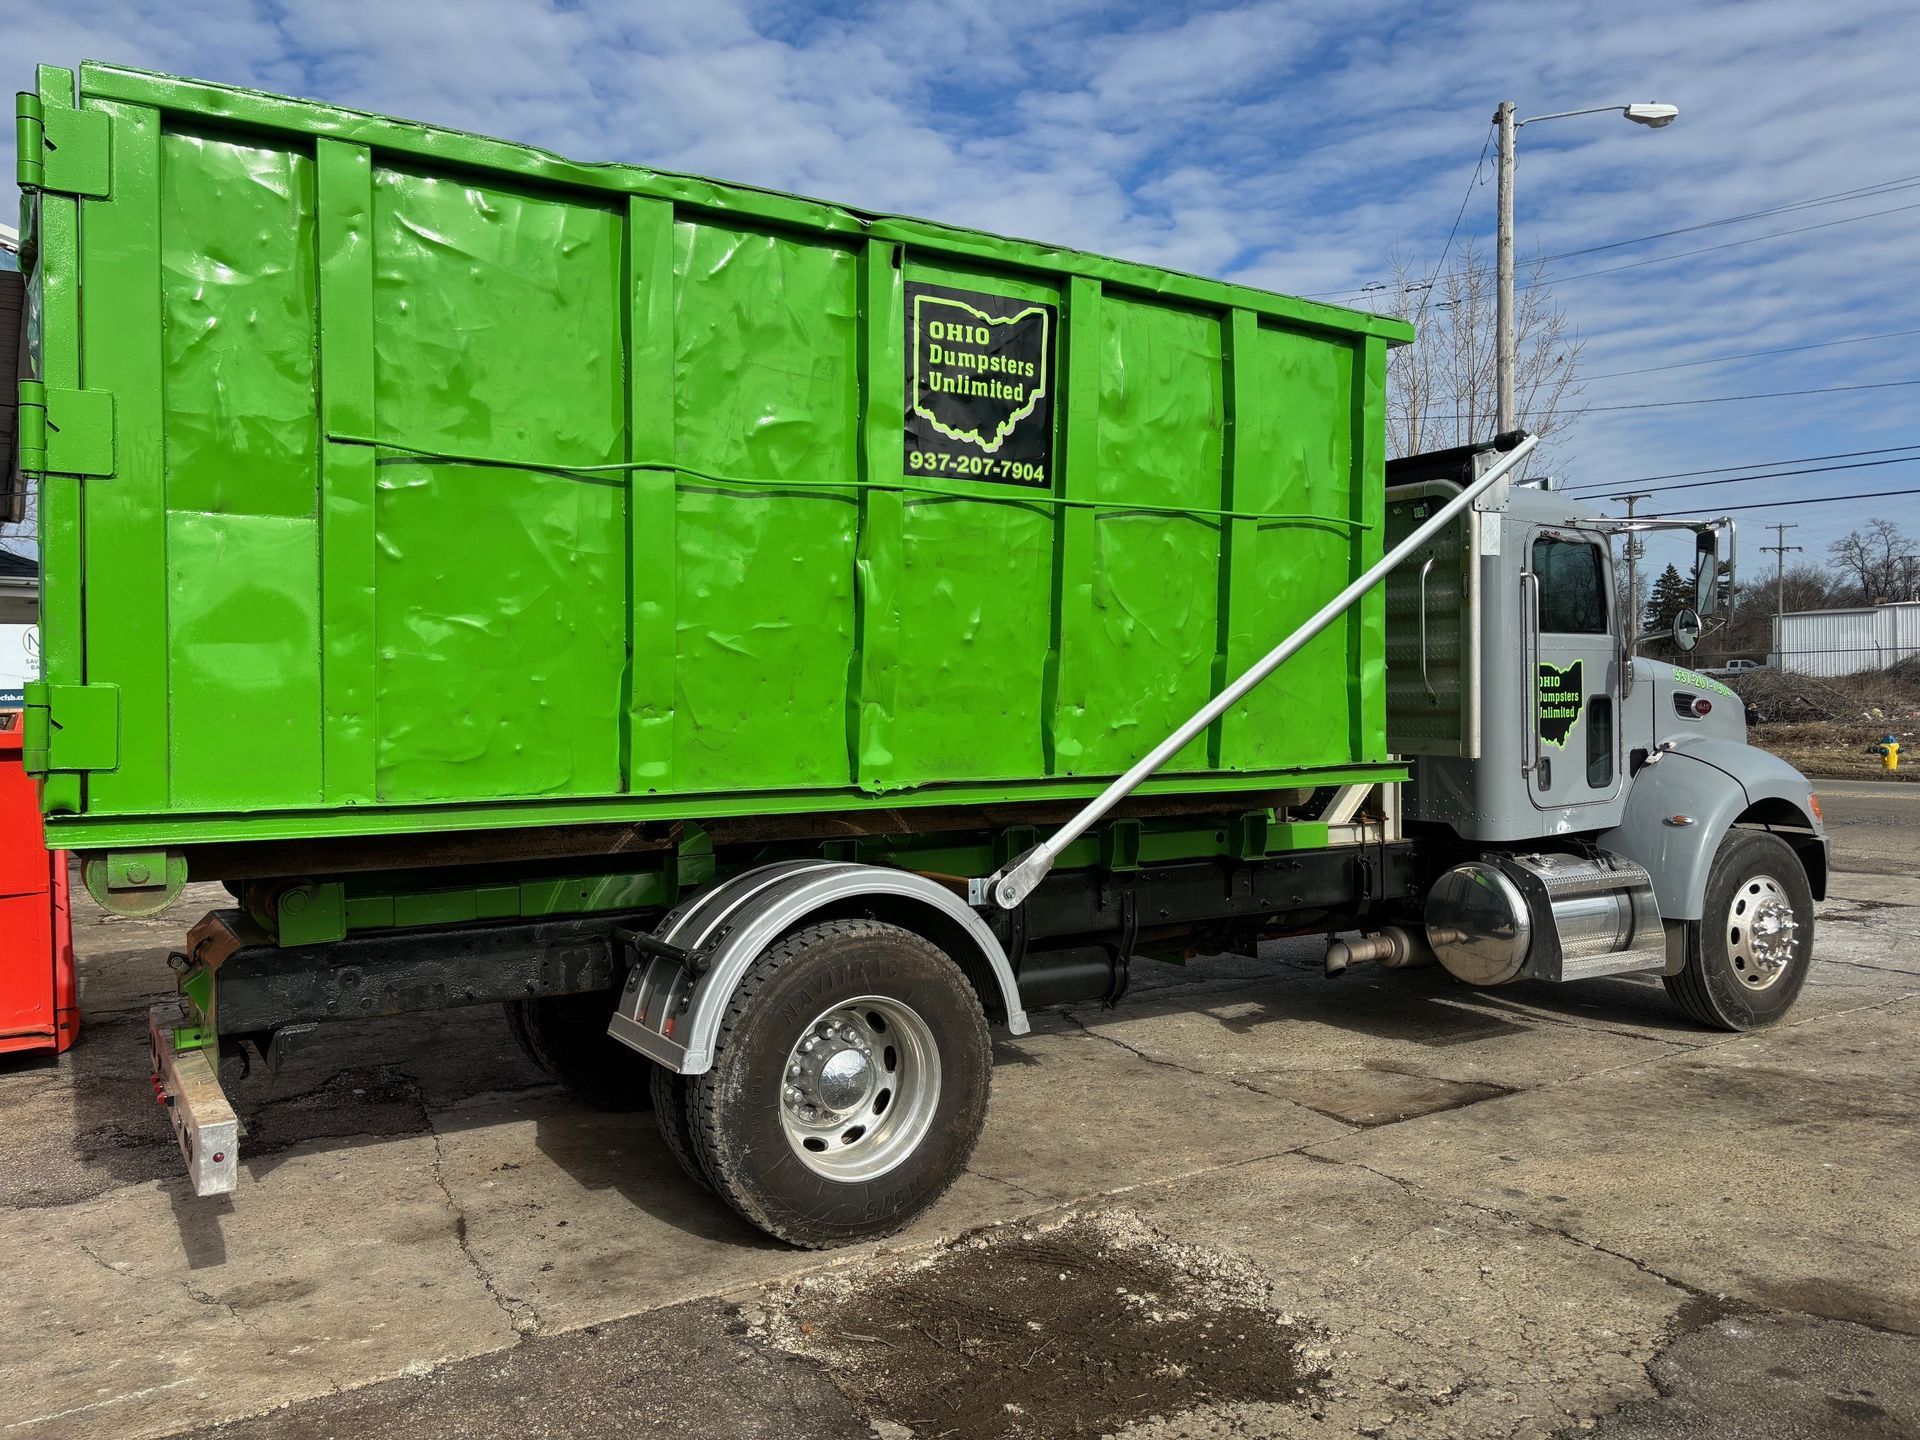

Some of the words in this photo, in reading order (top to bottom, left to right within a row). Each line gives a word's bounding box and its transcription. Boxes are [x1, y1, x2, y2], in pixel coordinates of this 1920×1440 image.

[929, 321, 990, 345] OHIO
[929, 344, 1035, 377] Dumpsters
[929, 371, 1024, 402] Unlimited
[909, 451, 1045, 482] 937-207-7904
